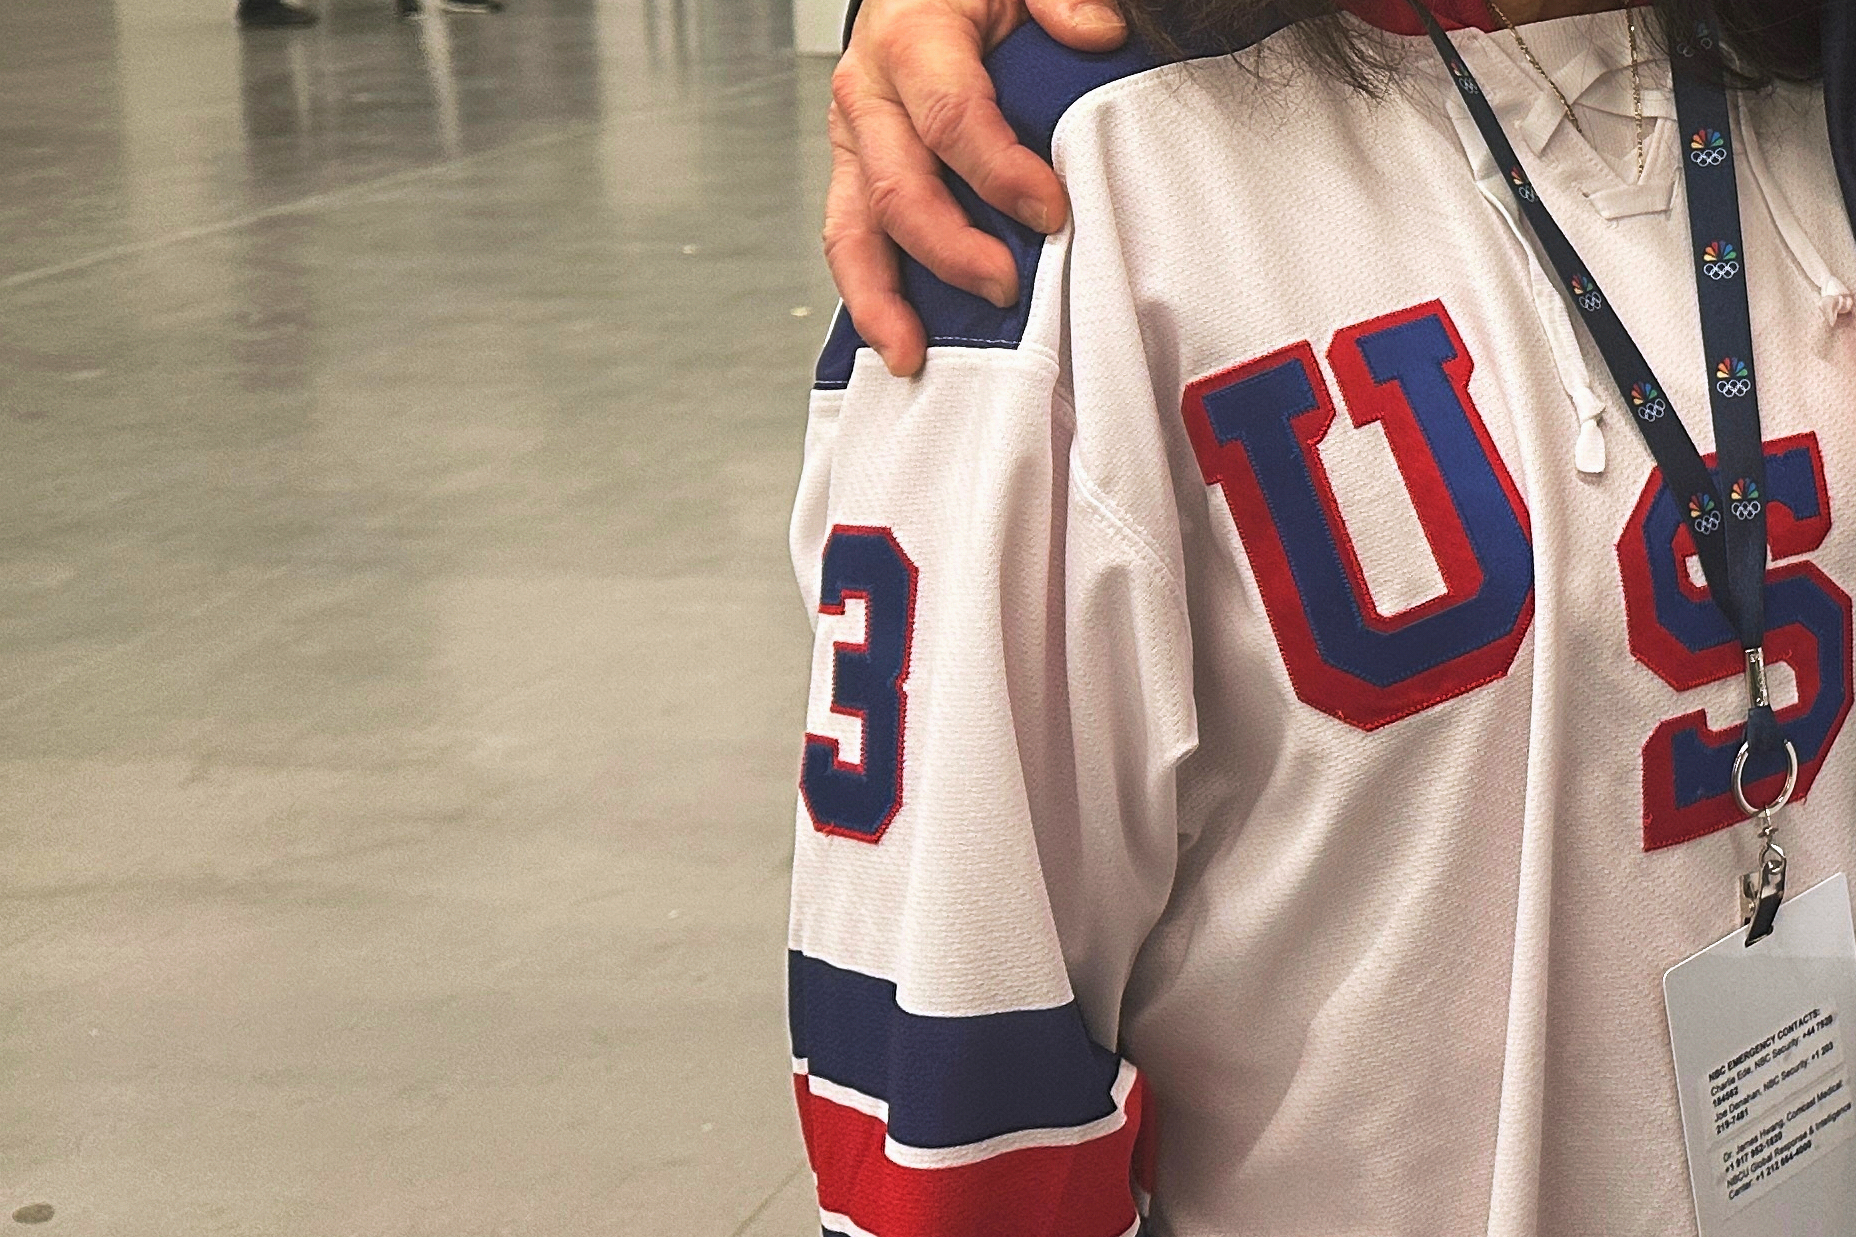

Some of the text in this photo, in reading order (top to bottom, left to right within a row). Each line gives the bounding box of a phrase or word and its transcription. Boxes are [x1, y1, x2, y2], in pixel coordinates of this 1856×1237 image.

[800, 524, 919, 845] 3
[1708, 1008, 1820, 1082] NBC EMERGENCY CONTACTS:
[1754, 1053, 1771, 1070] NBC
[1763, 1075, 1780, 1093] NBC
